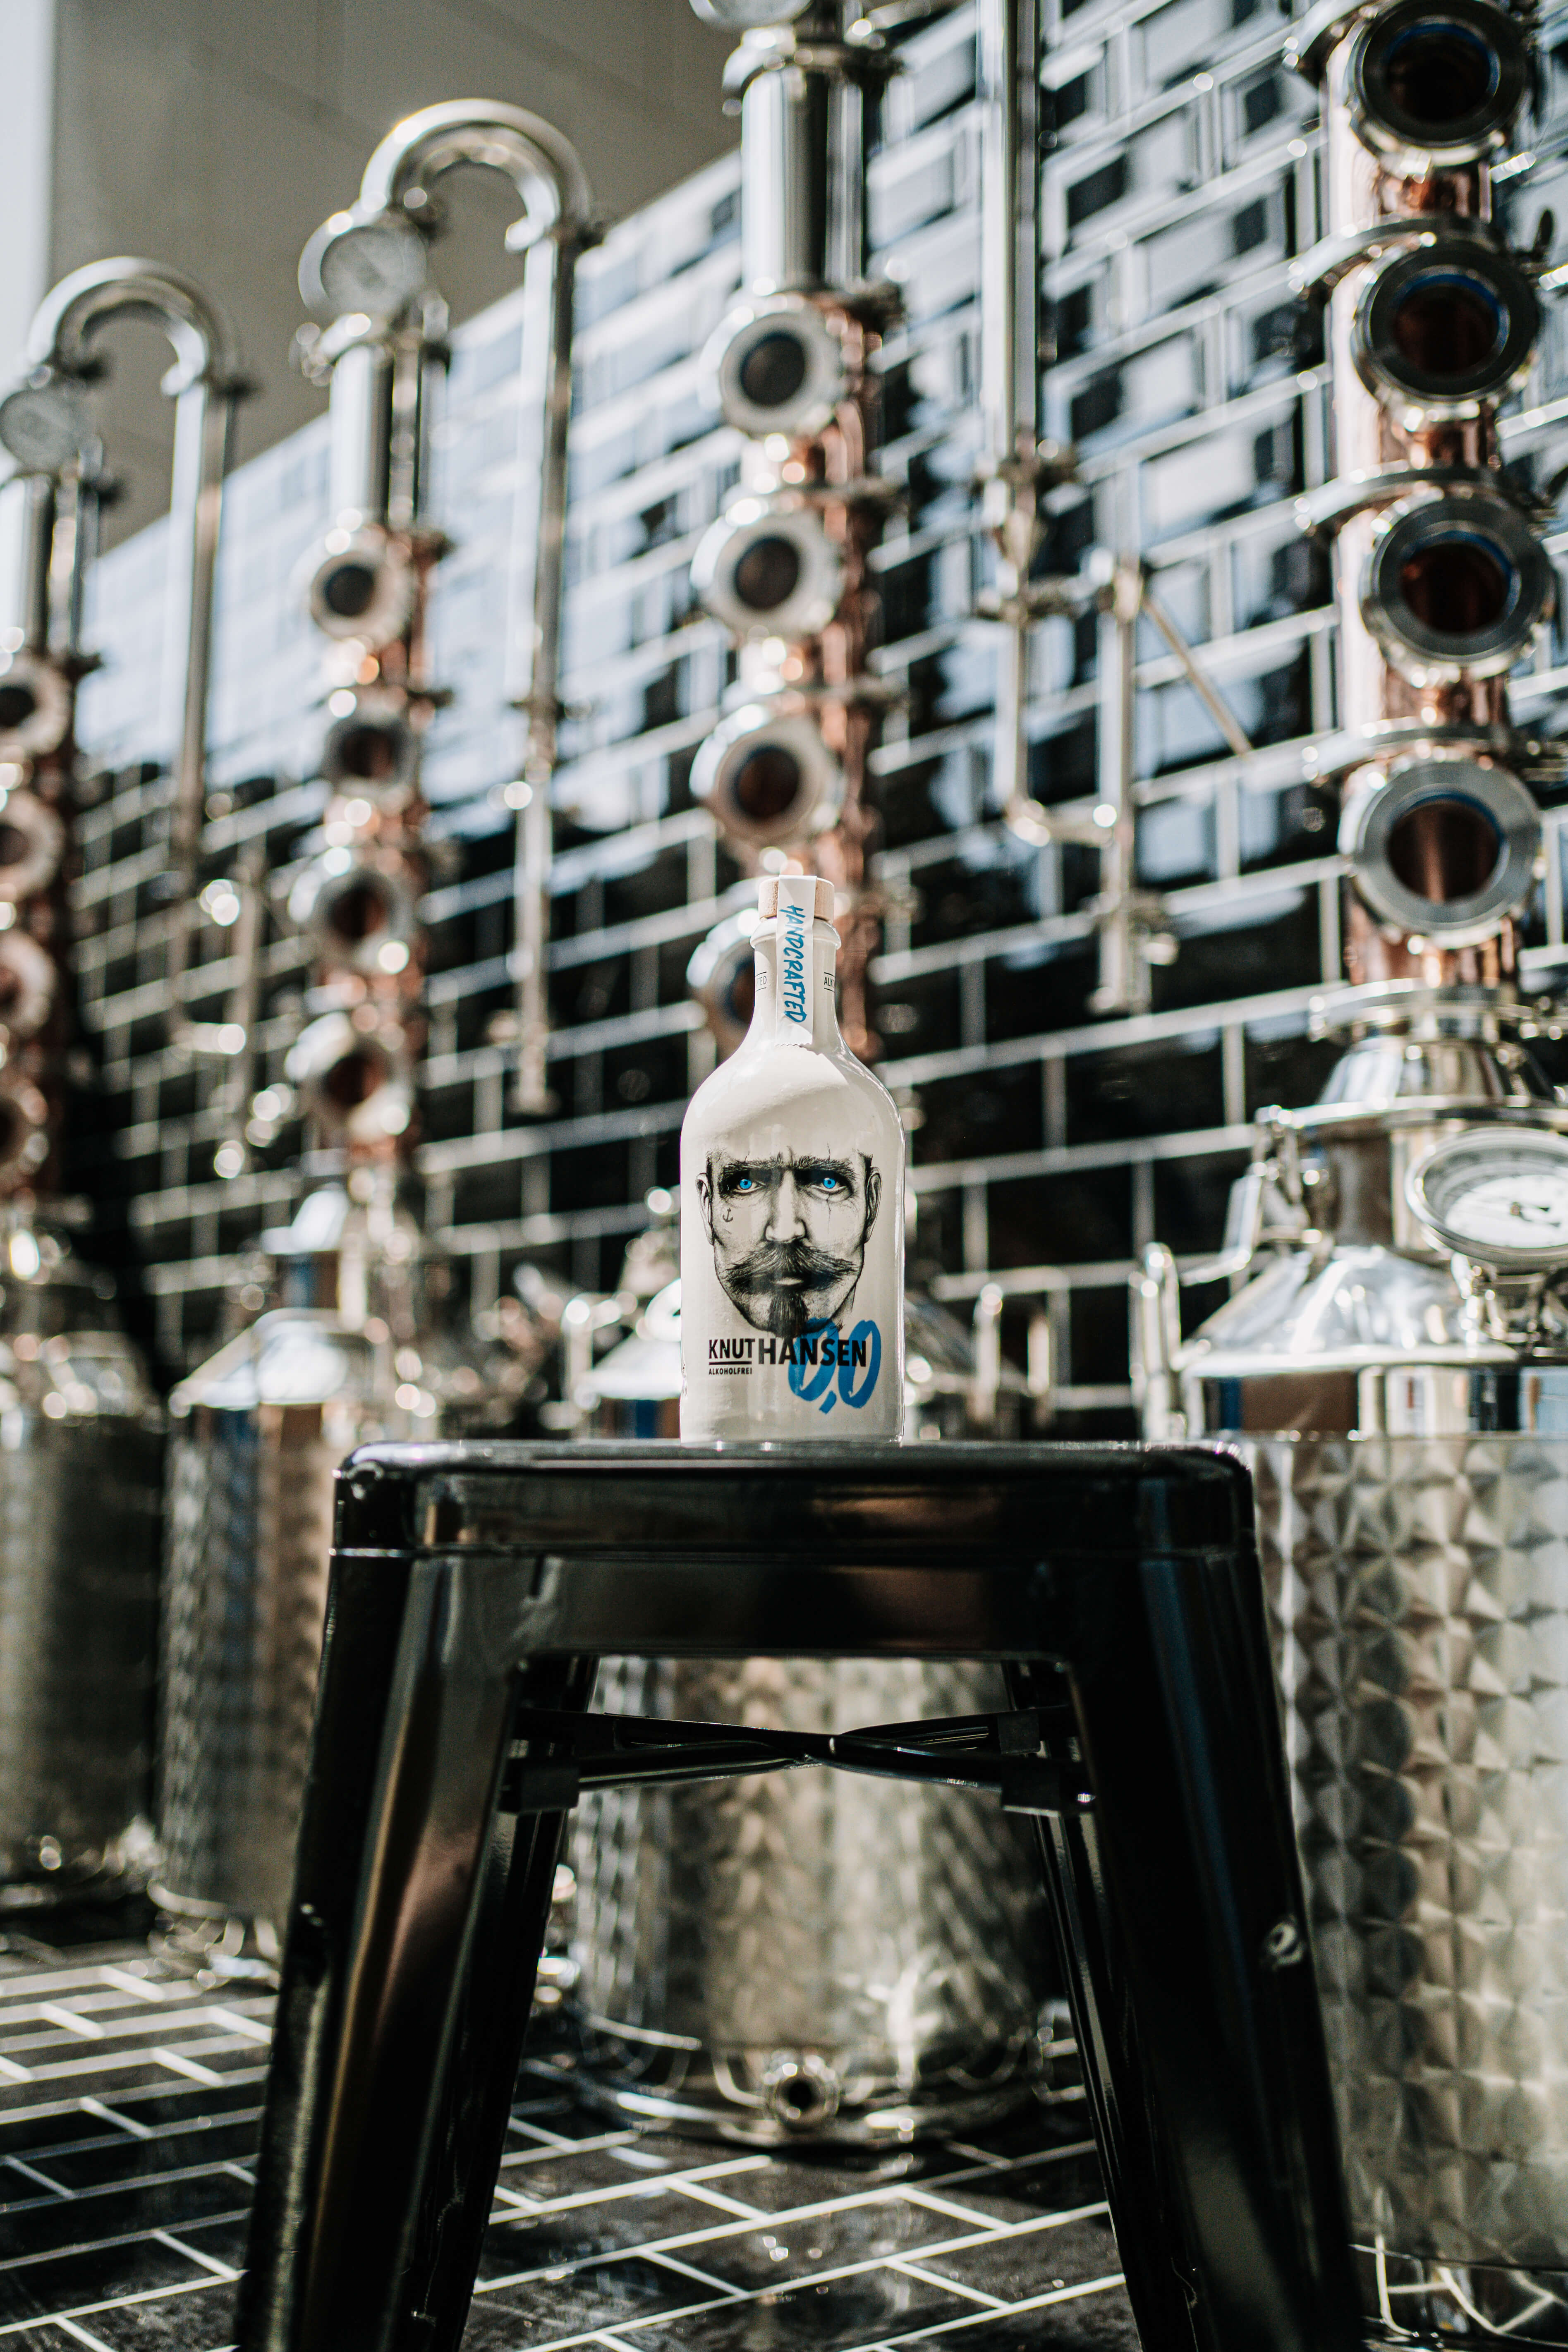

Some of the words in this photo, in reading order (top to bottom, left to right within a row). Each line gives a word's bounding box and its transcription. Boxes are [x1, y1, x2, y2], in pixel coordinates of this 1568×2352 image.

[778, 904, 808, 1023] HANDCRAFTED
[709, 1338, 755, 1359] KNUT
[758, 1338, 867, 1367] HANSEN
[709, 1367, 752, 1375] ALKOHOLFREI
